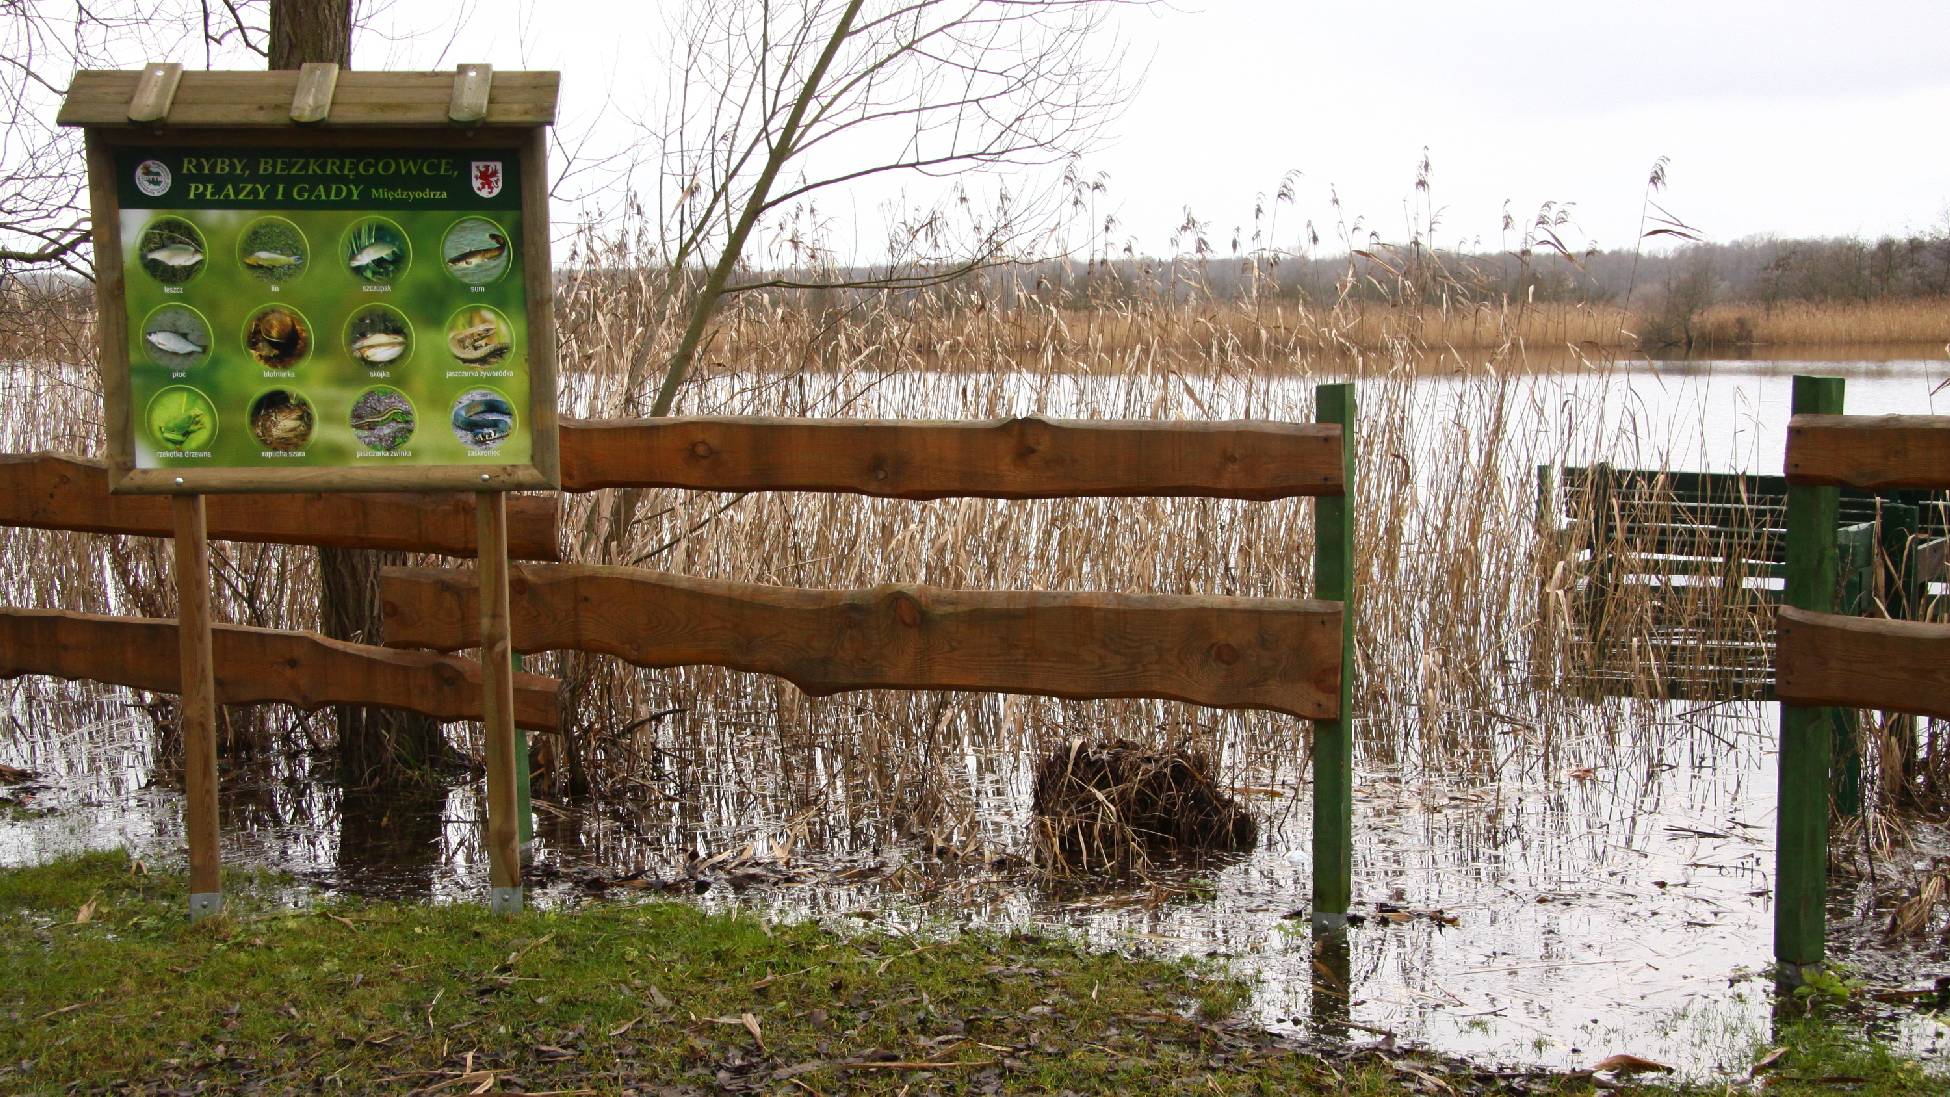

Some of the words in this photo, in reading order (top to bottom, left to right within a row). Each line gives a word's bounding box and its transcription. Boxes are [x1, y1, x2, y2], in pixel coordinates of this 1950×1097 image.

[182, 158, 249, 177] RYBY,
[258, 158, 459, 178] BEZKRĘGOWCE,
[188, 183, 270, 200] PŁAZY
[276, 183, 287, 200] I
[293, 183, 365, 200] GADY
[371, 187, 447, 201] Międzyodrza
